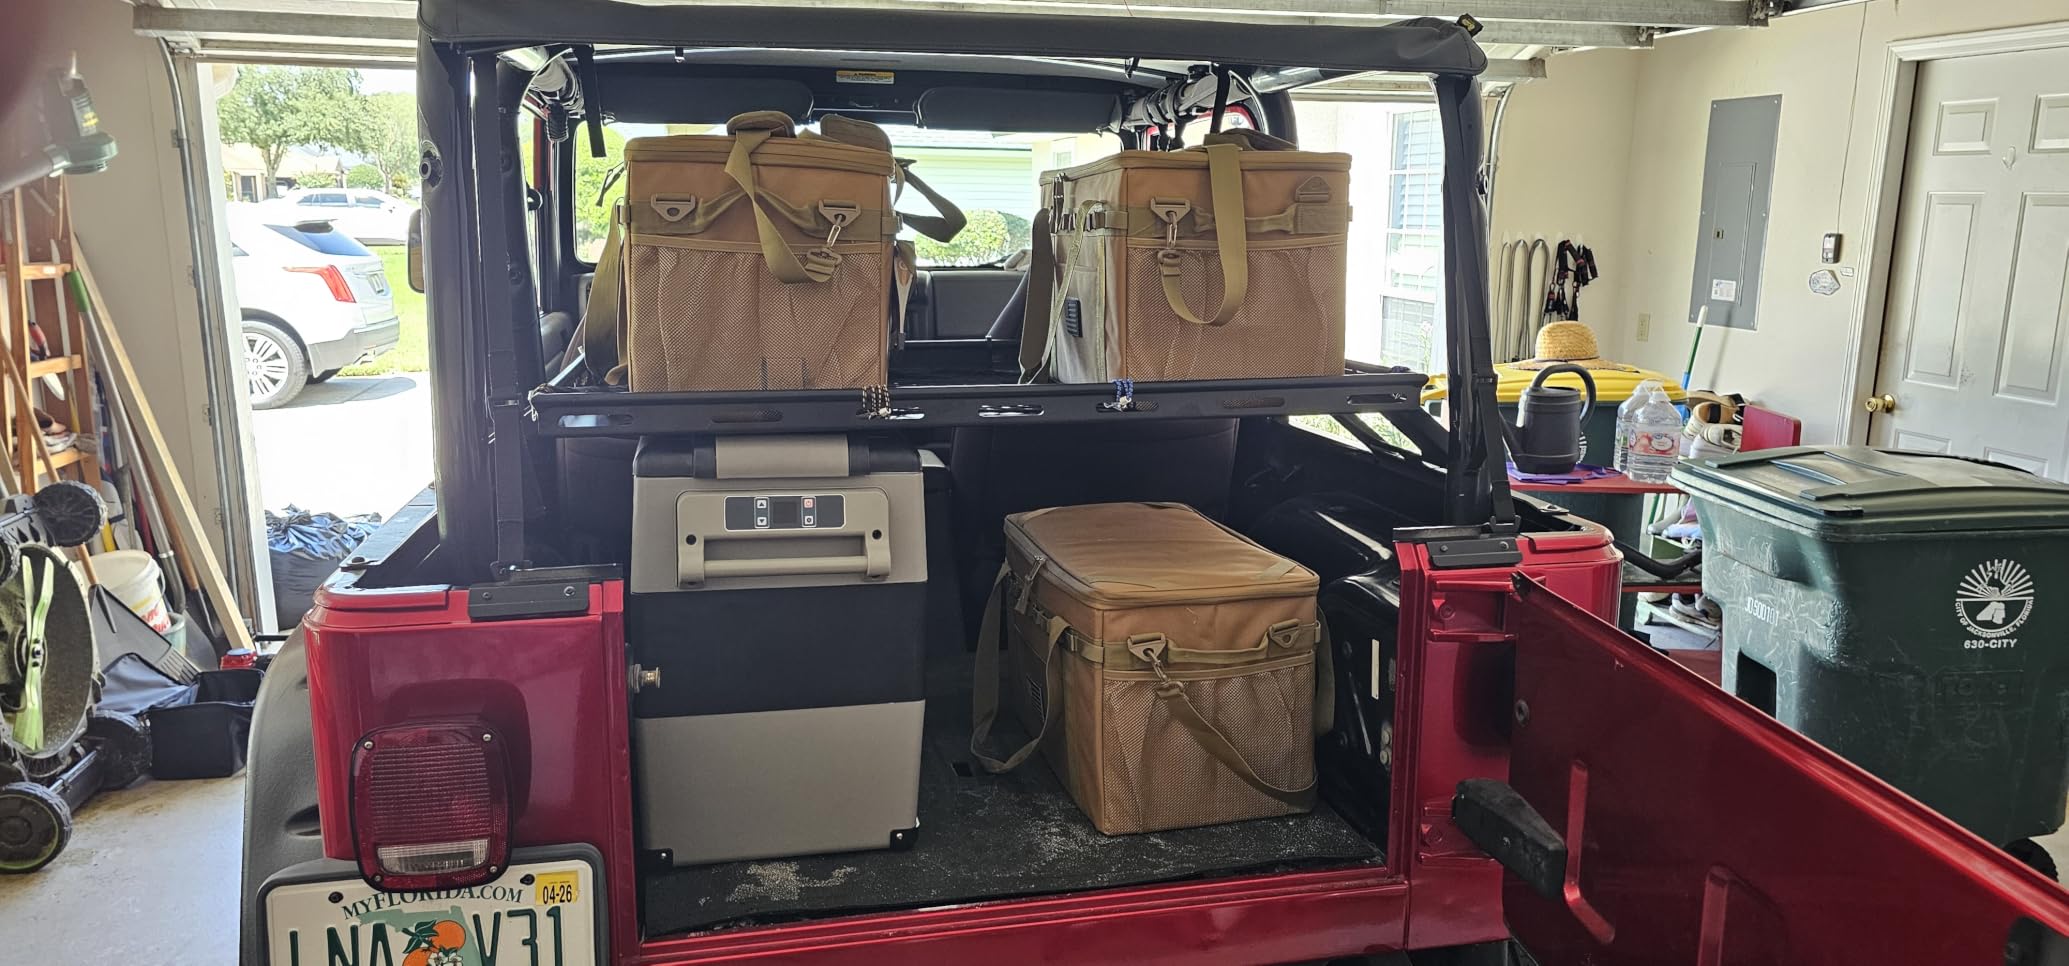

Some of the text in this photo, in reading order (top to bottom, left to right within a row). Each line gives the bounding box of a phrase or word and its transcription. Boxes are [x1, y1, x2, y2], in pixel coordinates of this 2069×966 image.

[1955, 602, 1963, 616] CITY
[1960, 617, 1968, 626] OF
[1963, 639, 2017, 649] 630-CITY
[542, 884, 572, 905] 04-26
